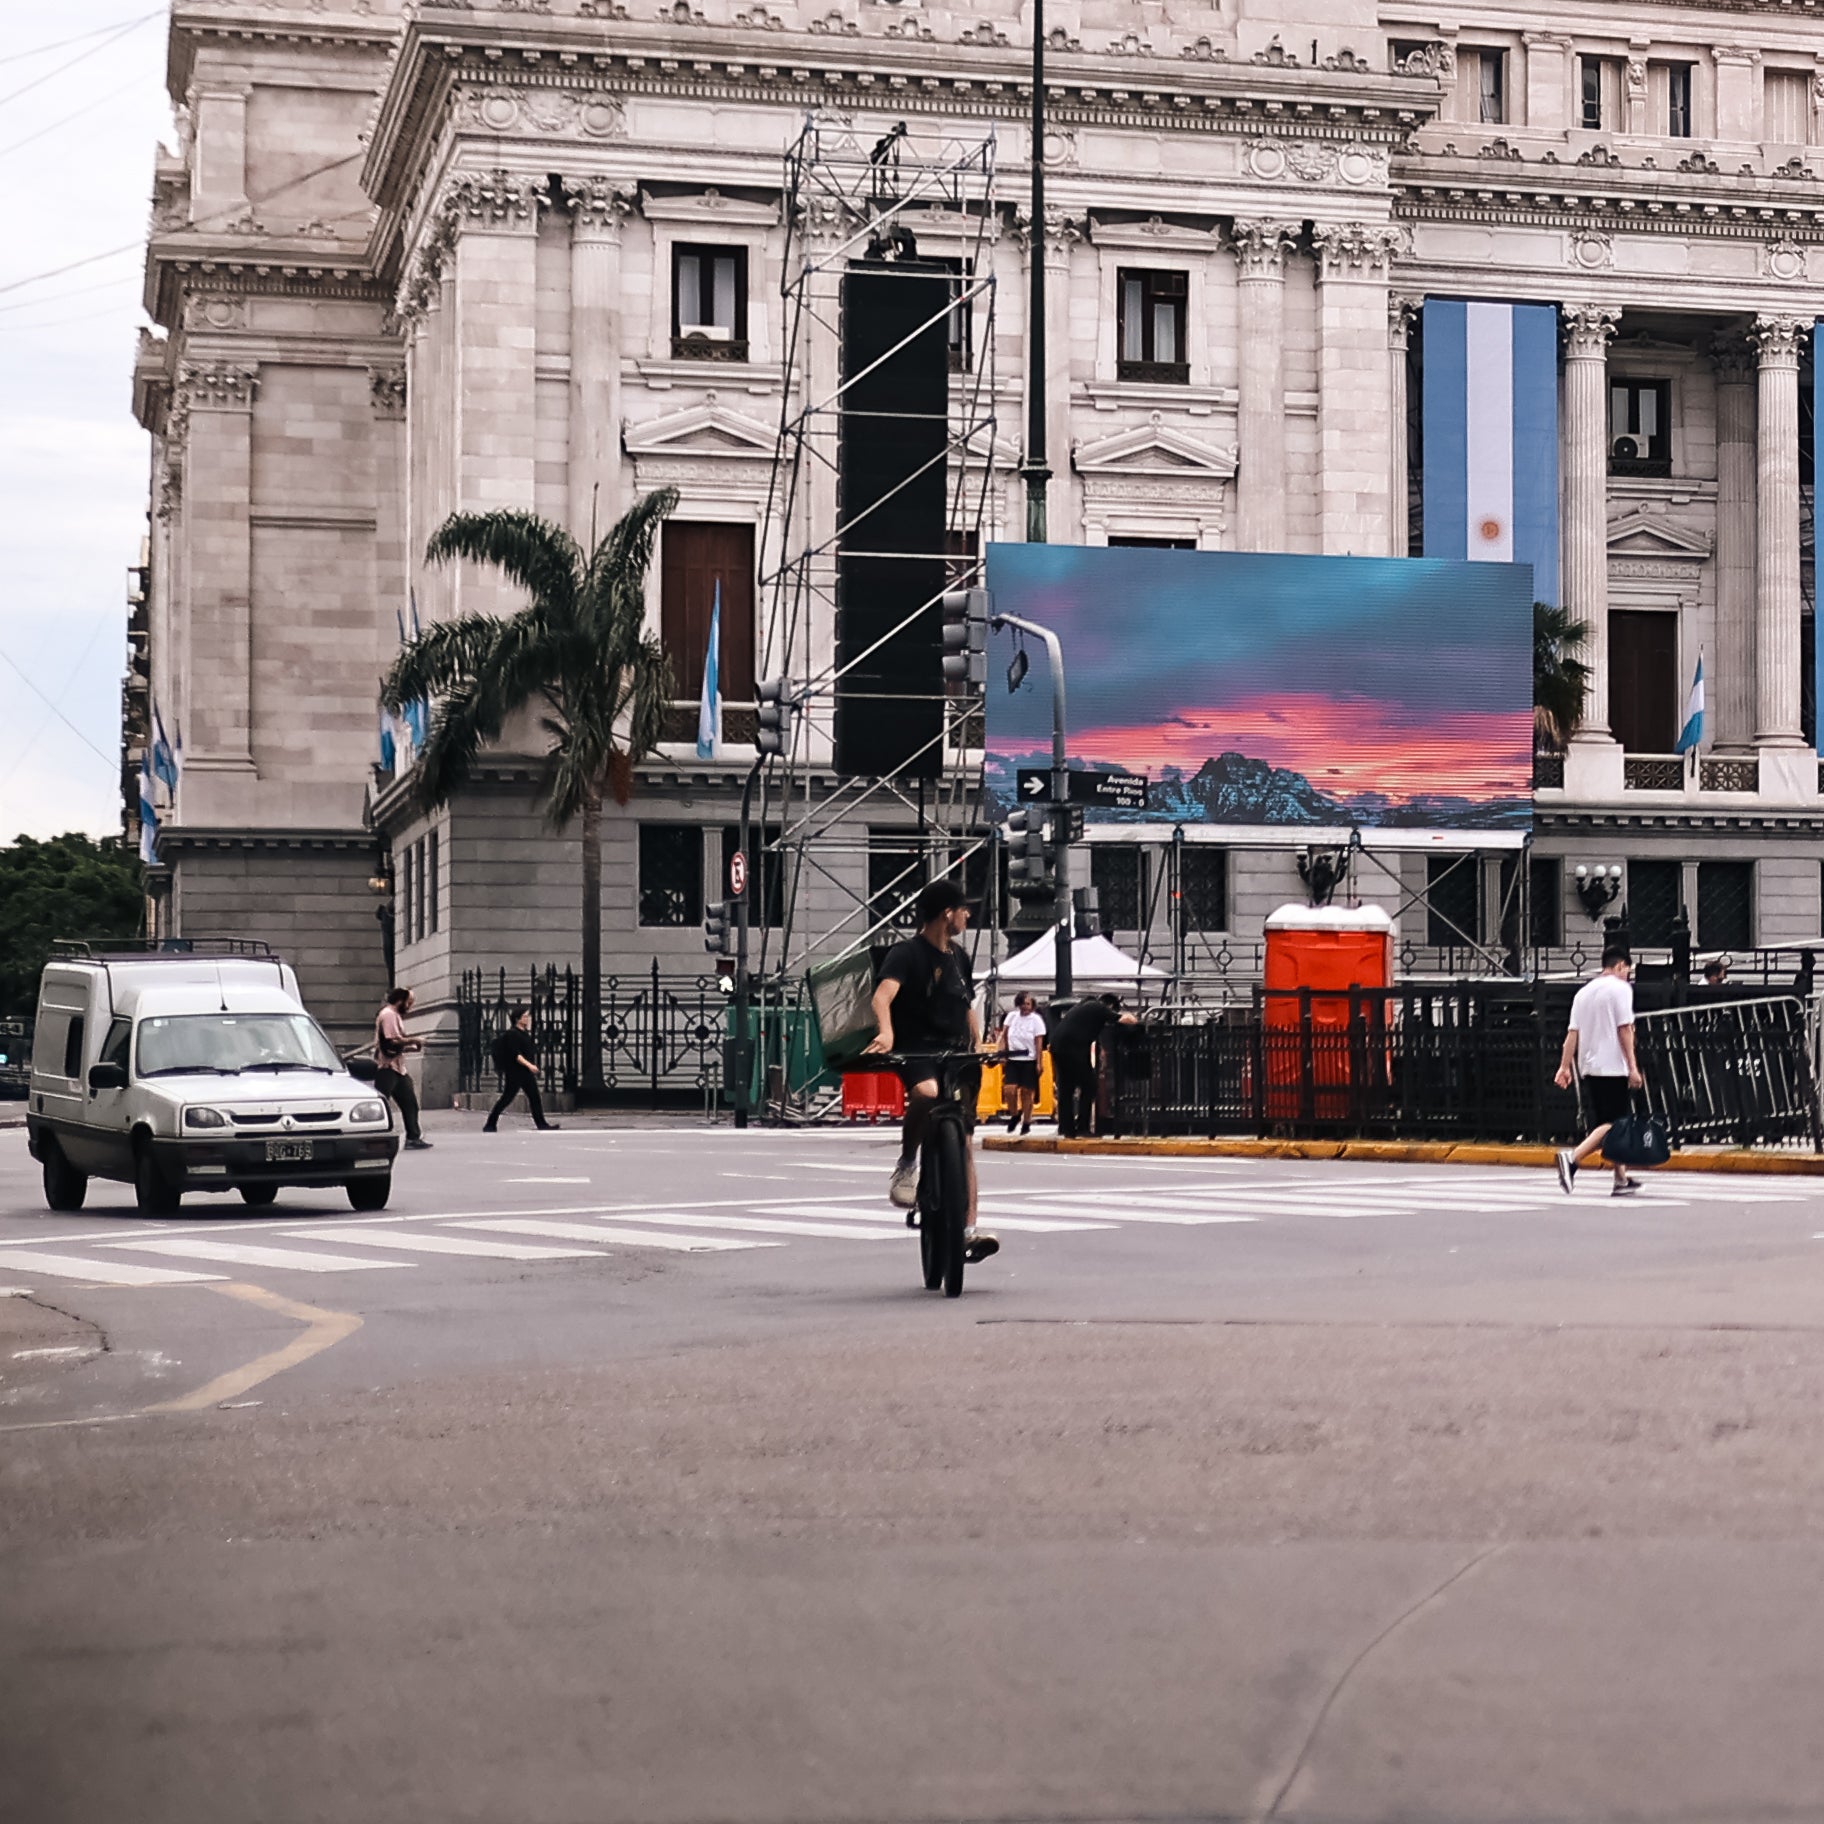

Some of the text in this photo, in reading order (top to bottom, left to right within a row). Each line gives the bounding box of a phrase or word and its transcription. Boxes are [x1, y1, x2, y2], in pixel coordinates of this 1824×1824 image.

[1107, 775, 1144, 785] Avenida
[1096, 784, 1121, 794] Entre
[1116, 797, 1132, 806] 100
